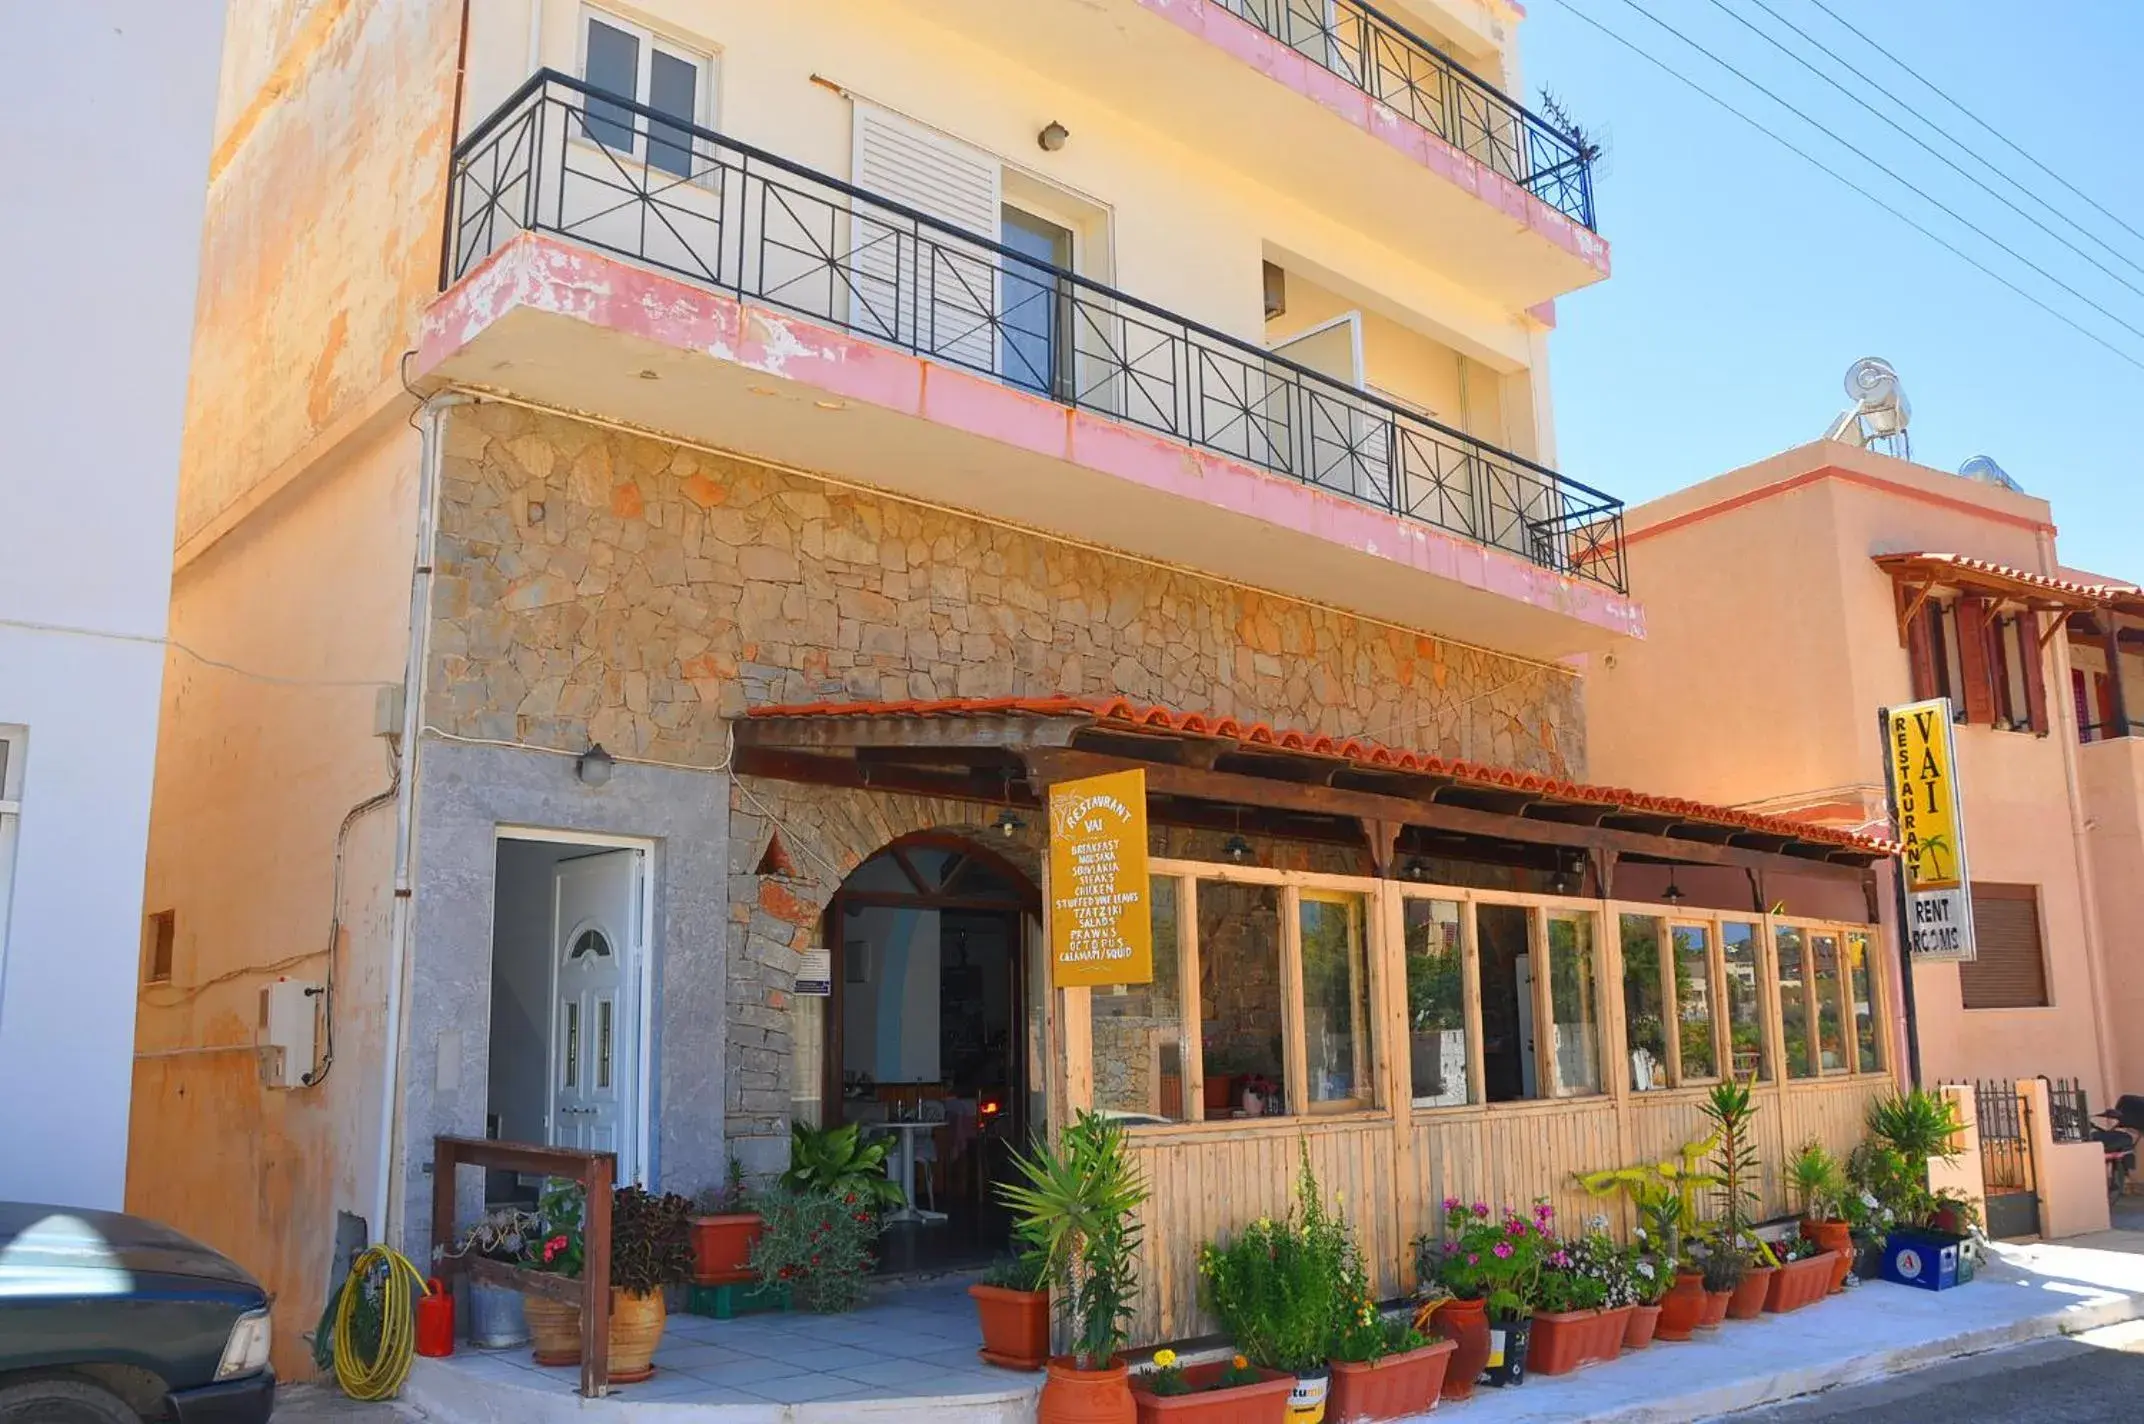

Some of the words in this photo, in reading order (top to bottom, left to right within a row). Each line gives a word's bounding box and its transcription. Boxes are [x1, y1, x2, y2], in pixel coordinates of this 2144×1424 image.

[1914, 710, 1942, 814] VAI
[1895, 717, 1921, 879] RESTAURANT
[1066, 795, 1133, 830] RESTAURANT
[1084, 819, 1103, 834] VAI
[1074, 883, 1115, 896] CHICKEN
[1073, 905, 1123, 918] TZATZIKI
[1915, 899, 1949, 924] RENT
[1079, 916, 1115, 928] SALADS
[1070, 927, 1117, 940] PRAWNS
